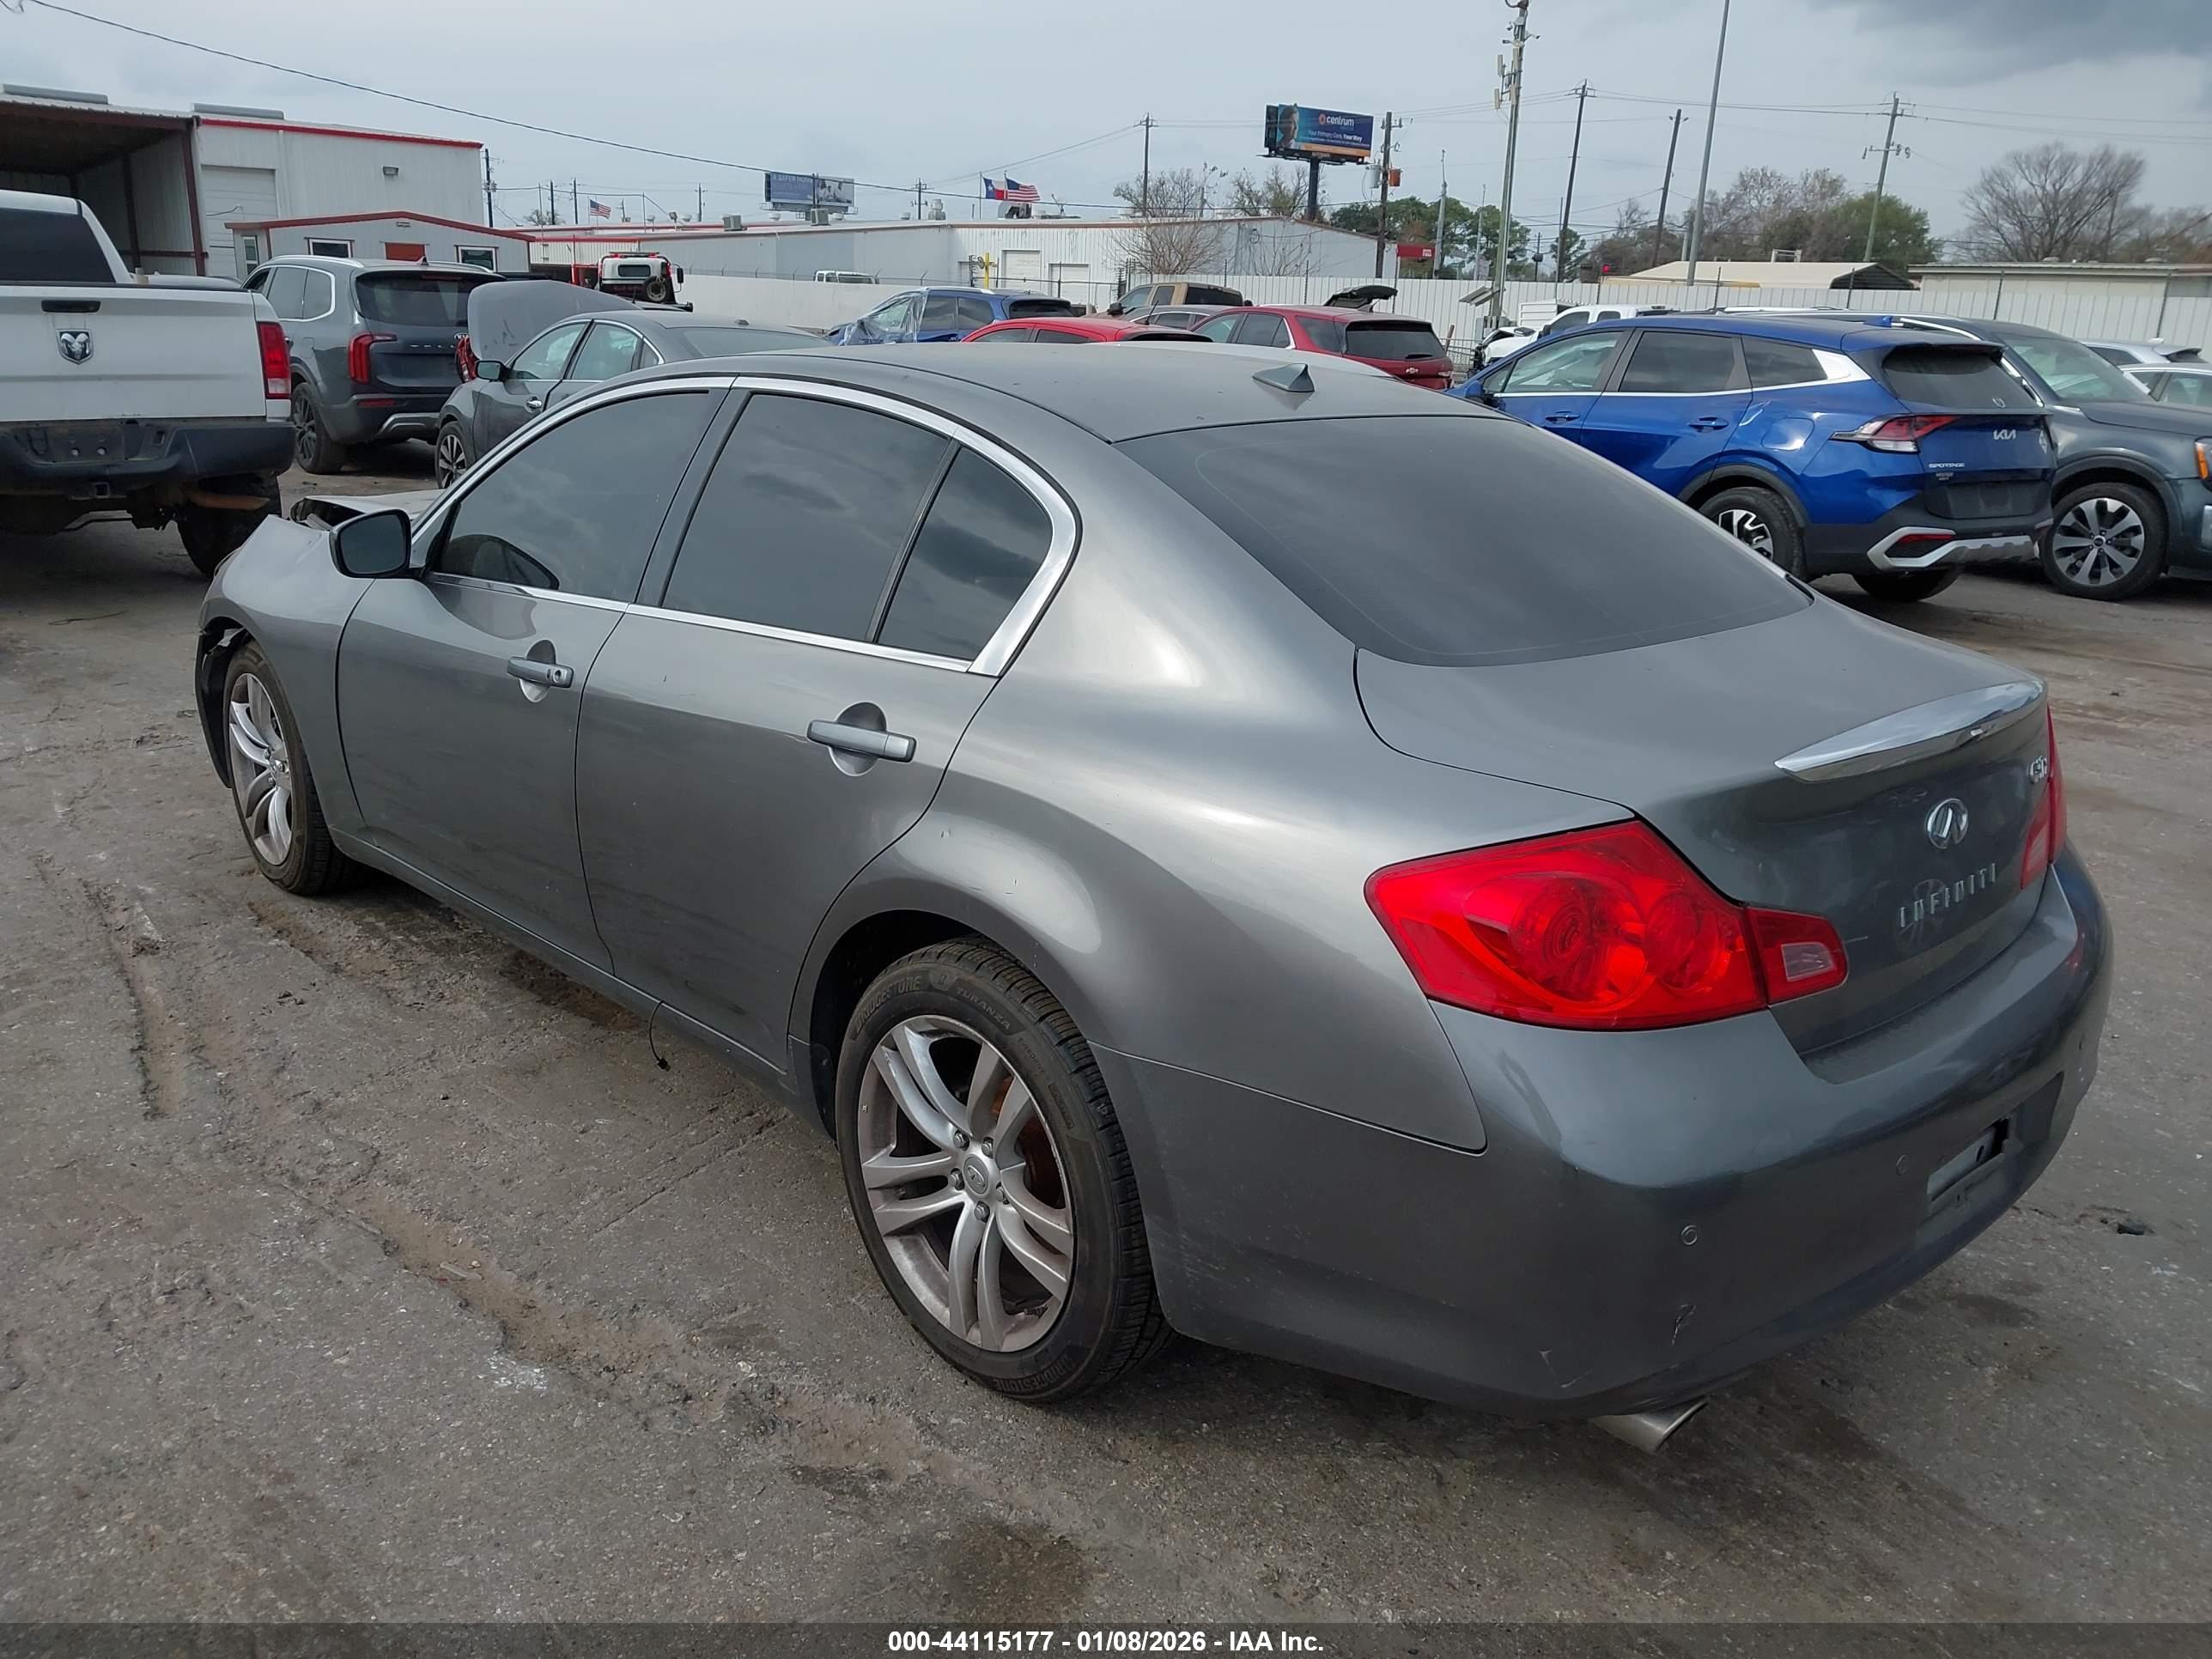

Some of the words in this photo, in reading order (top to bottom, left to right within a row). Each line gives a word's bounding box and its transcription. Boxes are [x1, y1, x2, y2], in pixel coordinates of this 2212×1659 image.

[1327, 116, 1354, 126] centrum
[1993, 429, 2017, 440] KIA
[1899, 862, 1997, 928] INFINITI
[955, 988, 1012, 1031] TURANZA
